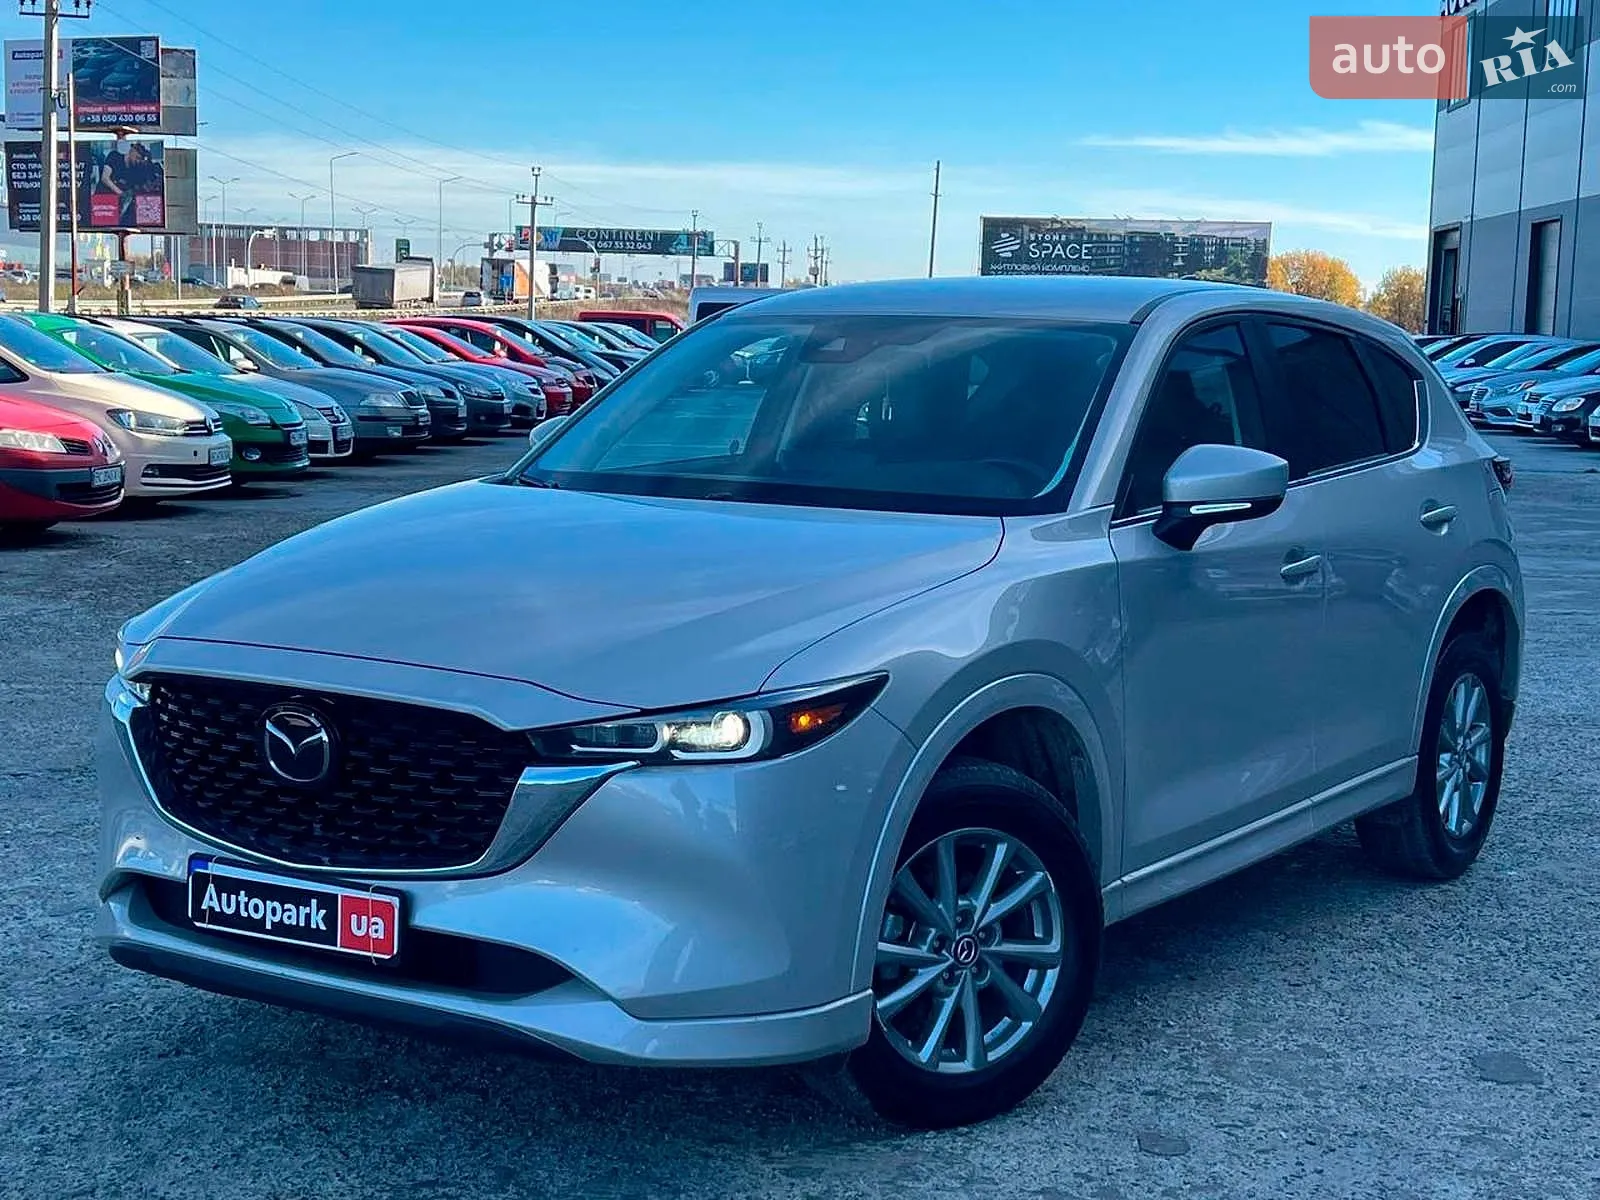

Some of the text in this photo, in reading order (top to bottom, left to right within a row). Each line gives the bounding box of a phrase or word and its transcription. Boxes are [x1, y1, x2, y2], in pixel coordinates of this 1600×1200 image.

[102, 113, 117, 122] 050
[118, 113, 134, 122] 430
[576, 229, 662, 241] CONTINENT
[1030, 233, 1067, 241] STONE
[1029, 243, 1093, 260] SPACE
[201, 883, 385, 940] Autopark ua
